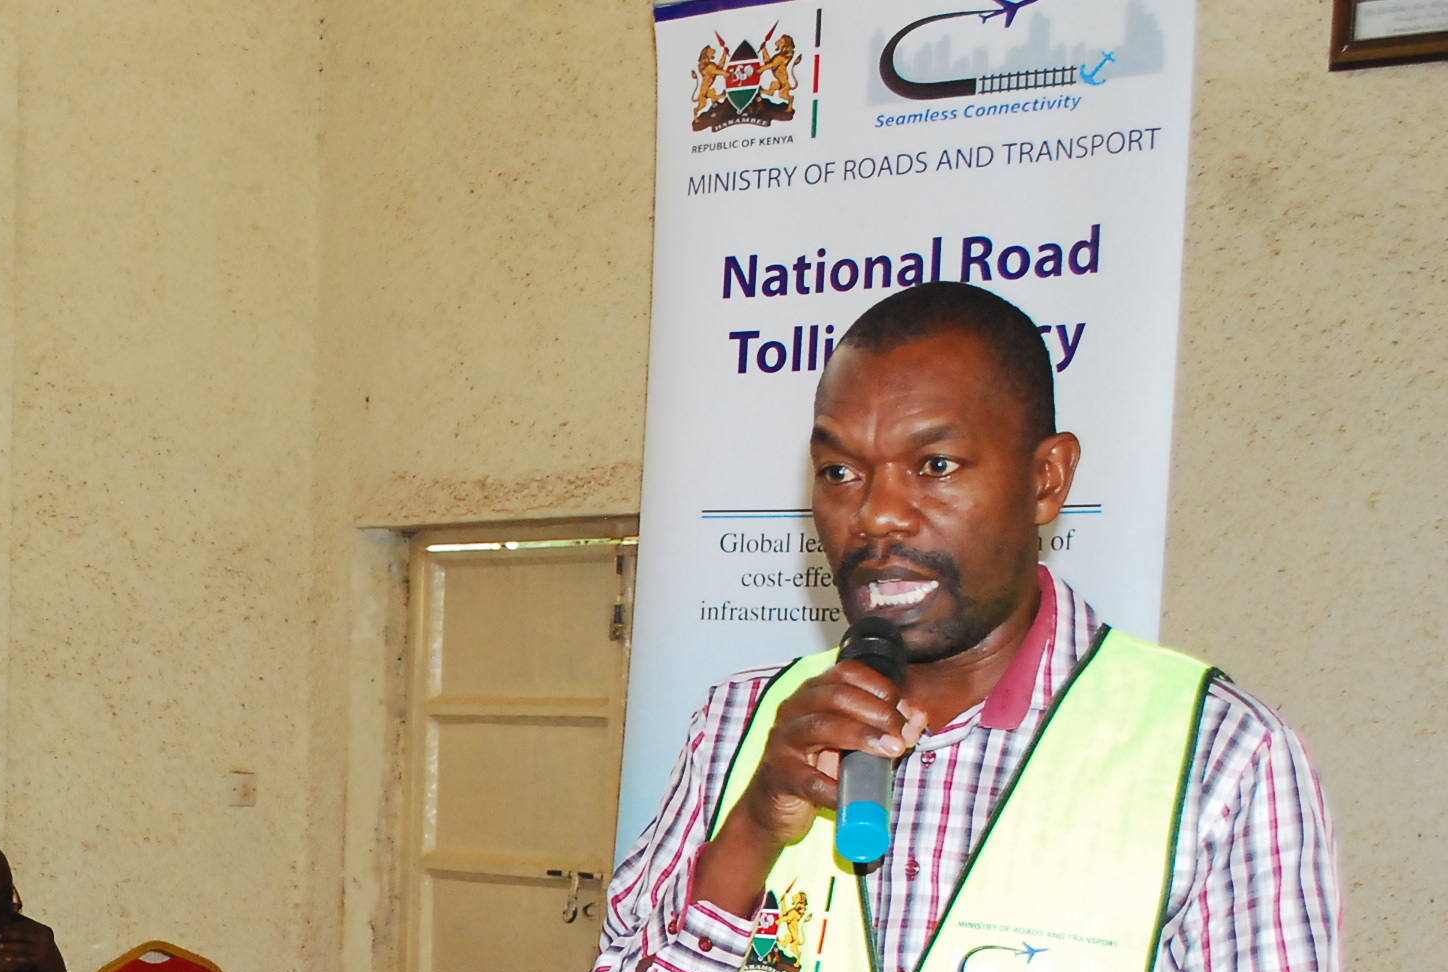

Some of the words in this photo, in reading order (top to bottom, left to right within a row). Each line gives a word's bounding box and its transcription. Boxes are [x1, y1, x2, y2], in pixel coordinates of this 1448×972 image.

[874, 107, 958, 128] Seamless
[963, 94, 1082, 120] Connectivity
[691, 139, 739, 154] REPUBLIC
[741, 138, 757, 148] OF
[758, 135, 794, 147] KENYA
[687, 165, 798, 197] MINISTRY
[804, 161, 836, 185] OF
[843, 151, 929, 181] ROADS
[935, 145, 995, 172] AND
[1001, 127, 1162, 165] TRANSPORT
[721, 236, 943, 299] National
[960, 223, 1102, 283] Road
[728, 324, 836, 375] Tolli
[719, 532, 791, 553] Global
[1050, 528, 1076, 551] of
[740, 566, 836, 588] cost-effe
[700, 600, 841, 622] infrastructure
[957, 920, 997, 932] MINISTRY
[1067, 933, 1120, 948] TRANSPORT
